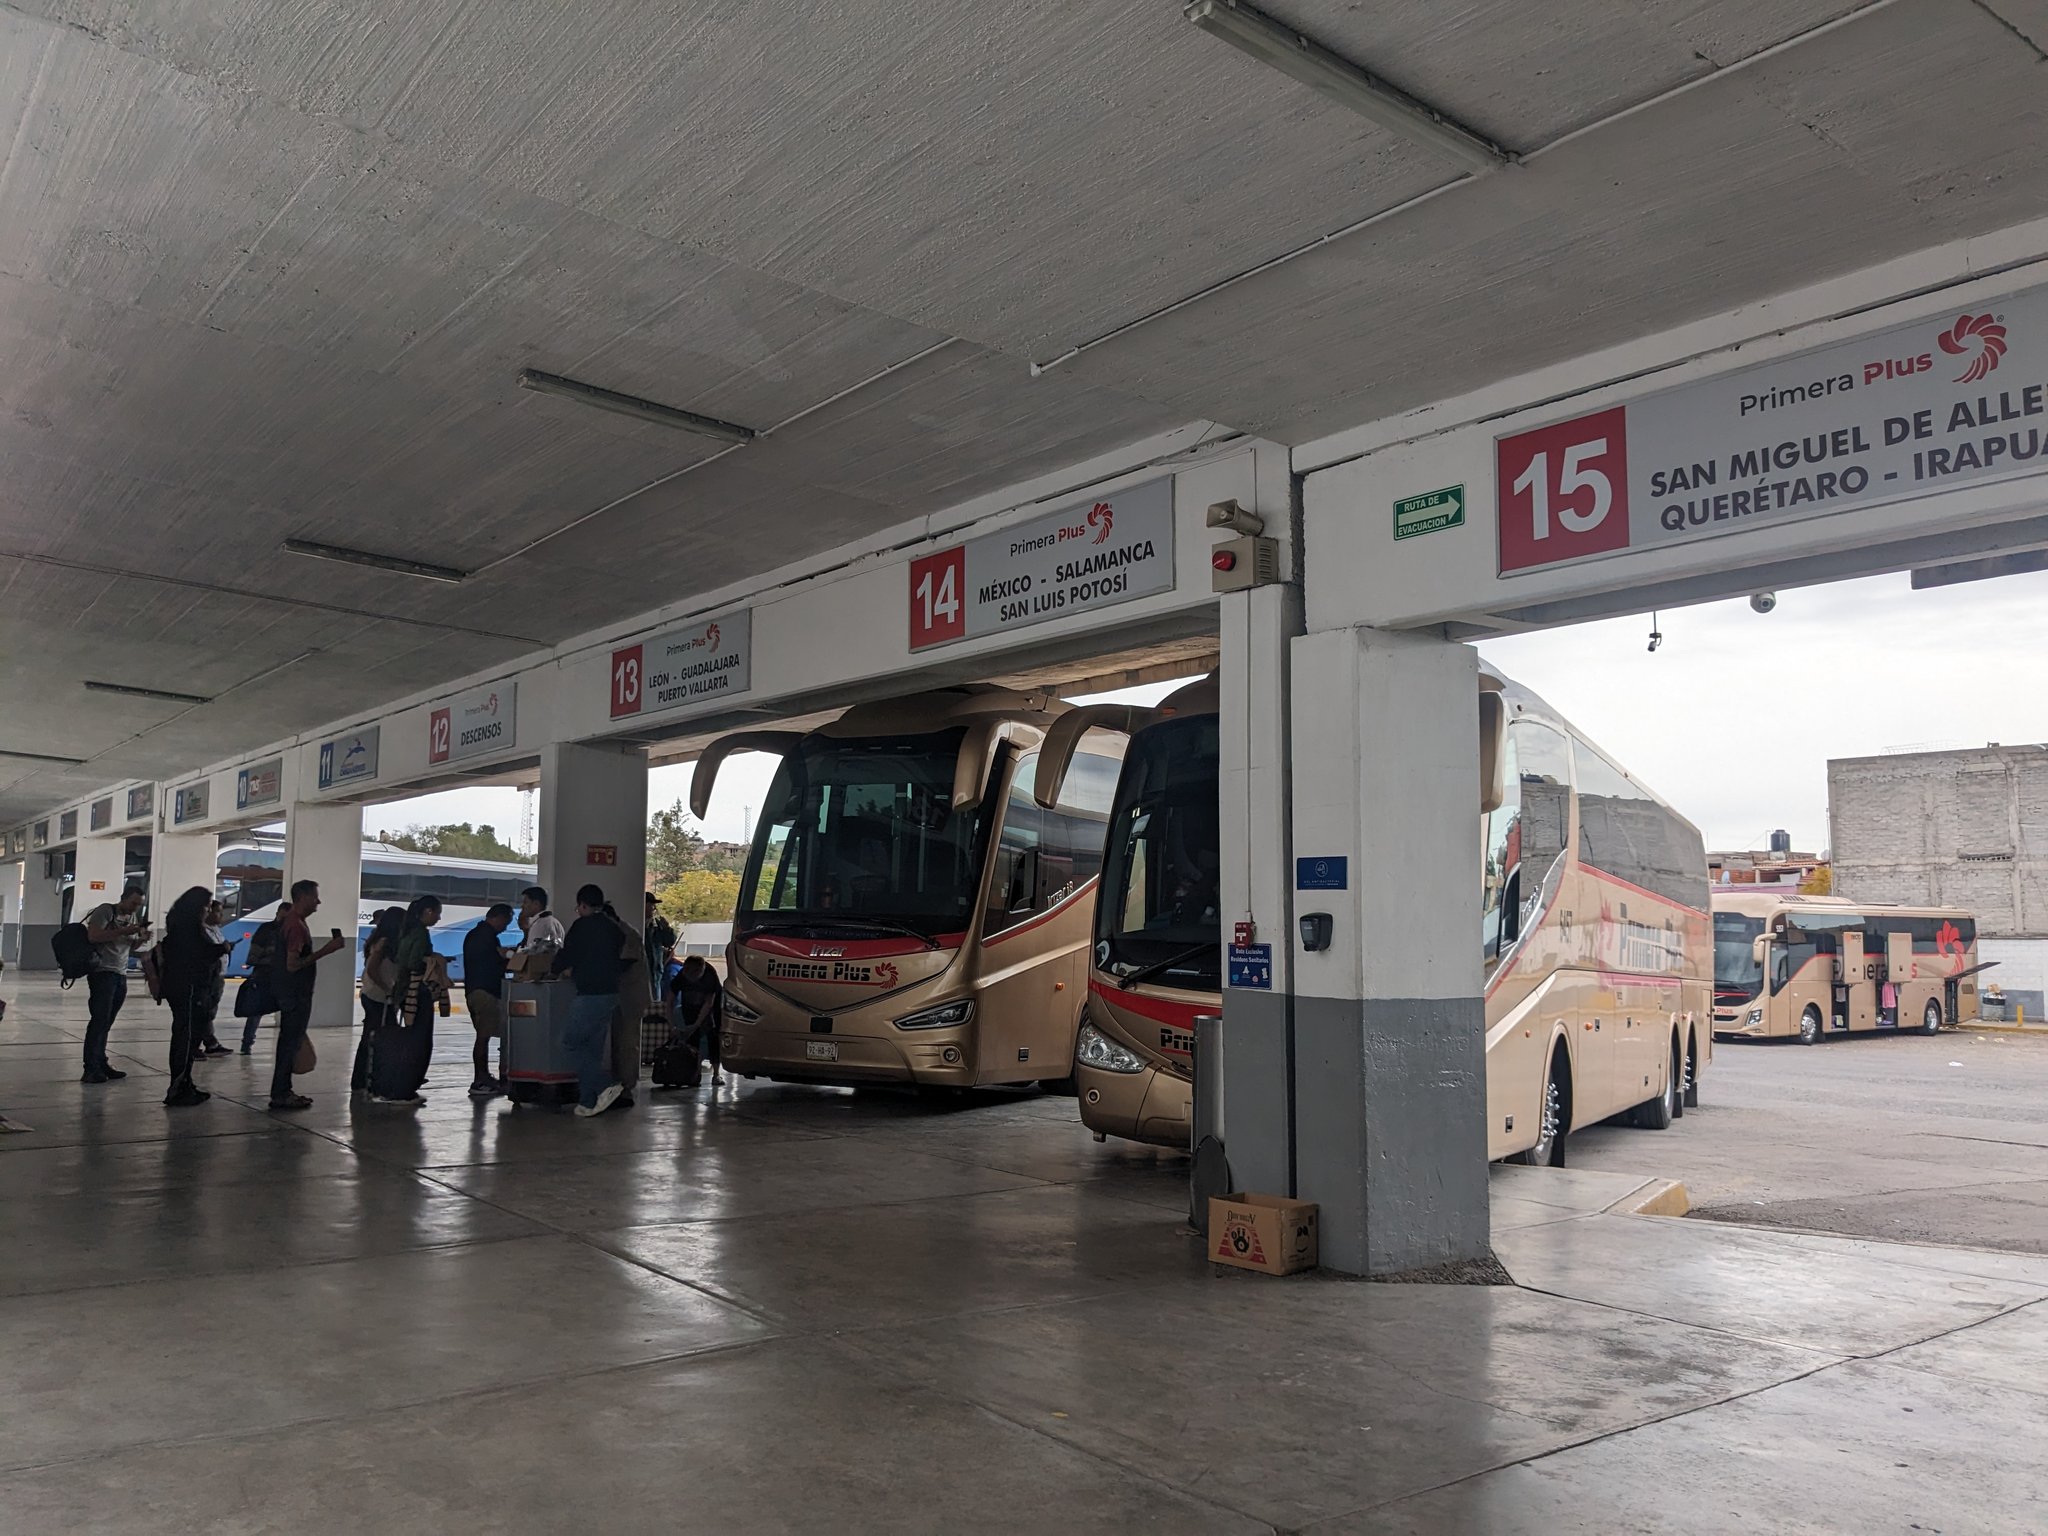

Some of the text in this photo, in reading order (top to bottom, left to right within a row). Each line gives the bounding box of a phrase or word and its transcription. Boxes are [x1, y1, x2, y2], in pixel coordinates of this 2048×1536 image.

[1740, 353, 1933, 417] Primera Plus
[1650, 384, 2048, 498] SAN MIGUEL DE ALLE
[1404, 495, 1440, 512] RUTA DE
[1513, 437, 1612, 541] 15
[1660, 465, 1869, 532] QUERÉTARO
[1010, 525, 1086, 557] Primera Plus
[1398, 516, 1446, 536] EVACUACION
[979, 575, 1032, 604] MÉXICO
[1055, 540, 1155, 583] SALAMANCA
[916, 565, 959, 630] 14
[1000, 567, 1128, 622] SAN LUIS POTOSÍ
[666, 638, 706, 656] Primera Plus
[615, 658, 639, 705] 13
[649, 670, 670, 688] LEÓN
[681, 653, 740, 680] GUADALAJARA
[658, 675, 728, 703] PUERTO VALLARTA
[432, 717, 448, 754] 12
[460, 721, 502, 746] DESCENSOS
[321, 749, 331, 780] 11
[809, 943, 848, 957] Irizar
[767, 958, 871, 982] Primera Plus
[1833, 958, 1888, 980] Pera
